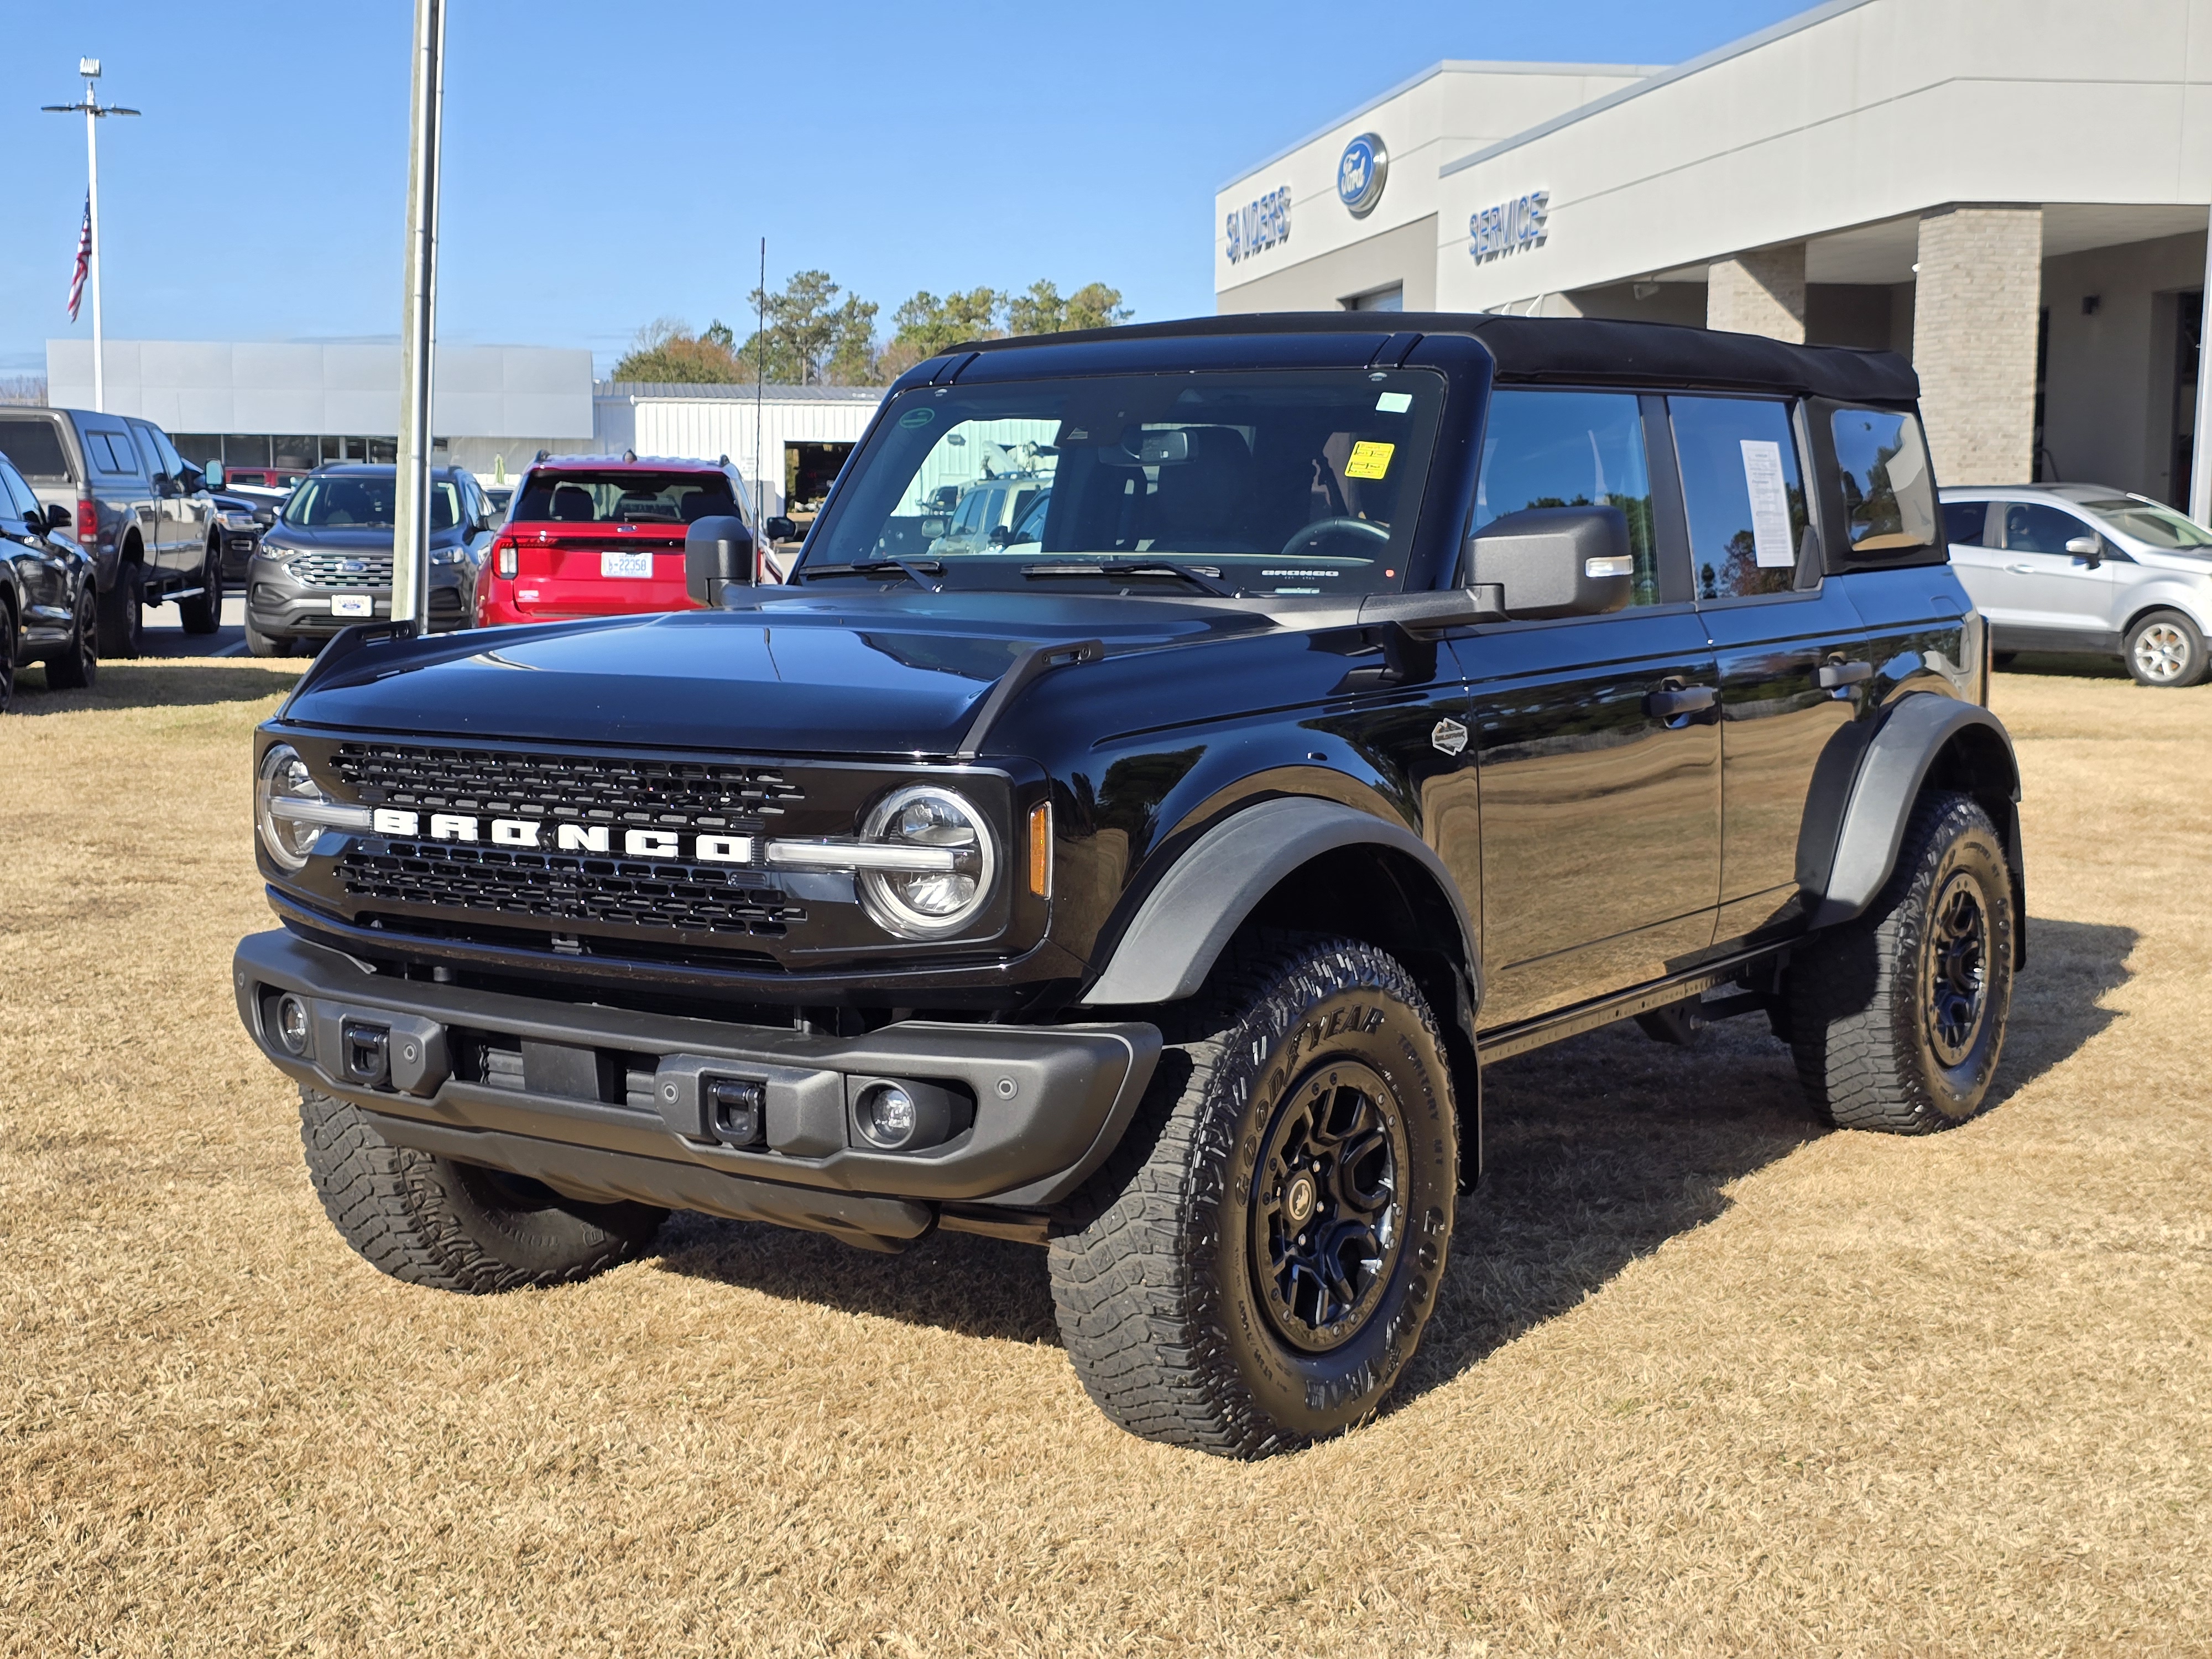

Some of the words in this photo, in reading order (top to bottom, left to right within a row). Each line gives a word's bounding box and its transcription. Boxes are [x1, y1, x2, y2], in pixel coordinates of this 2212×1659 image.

[1341, 150, 1366, 195] Ford
[1226, 186, 1291, 259] SANDERS
[1468, 191, 1548, 255] SERVICE
[374, 808, 752, 862] BRONCO
[1235, 1004, 1384, 1208] GOODYEAR
